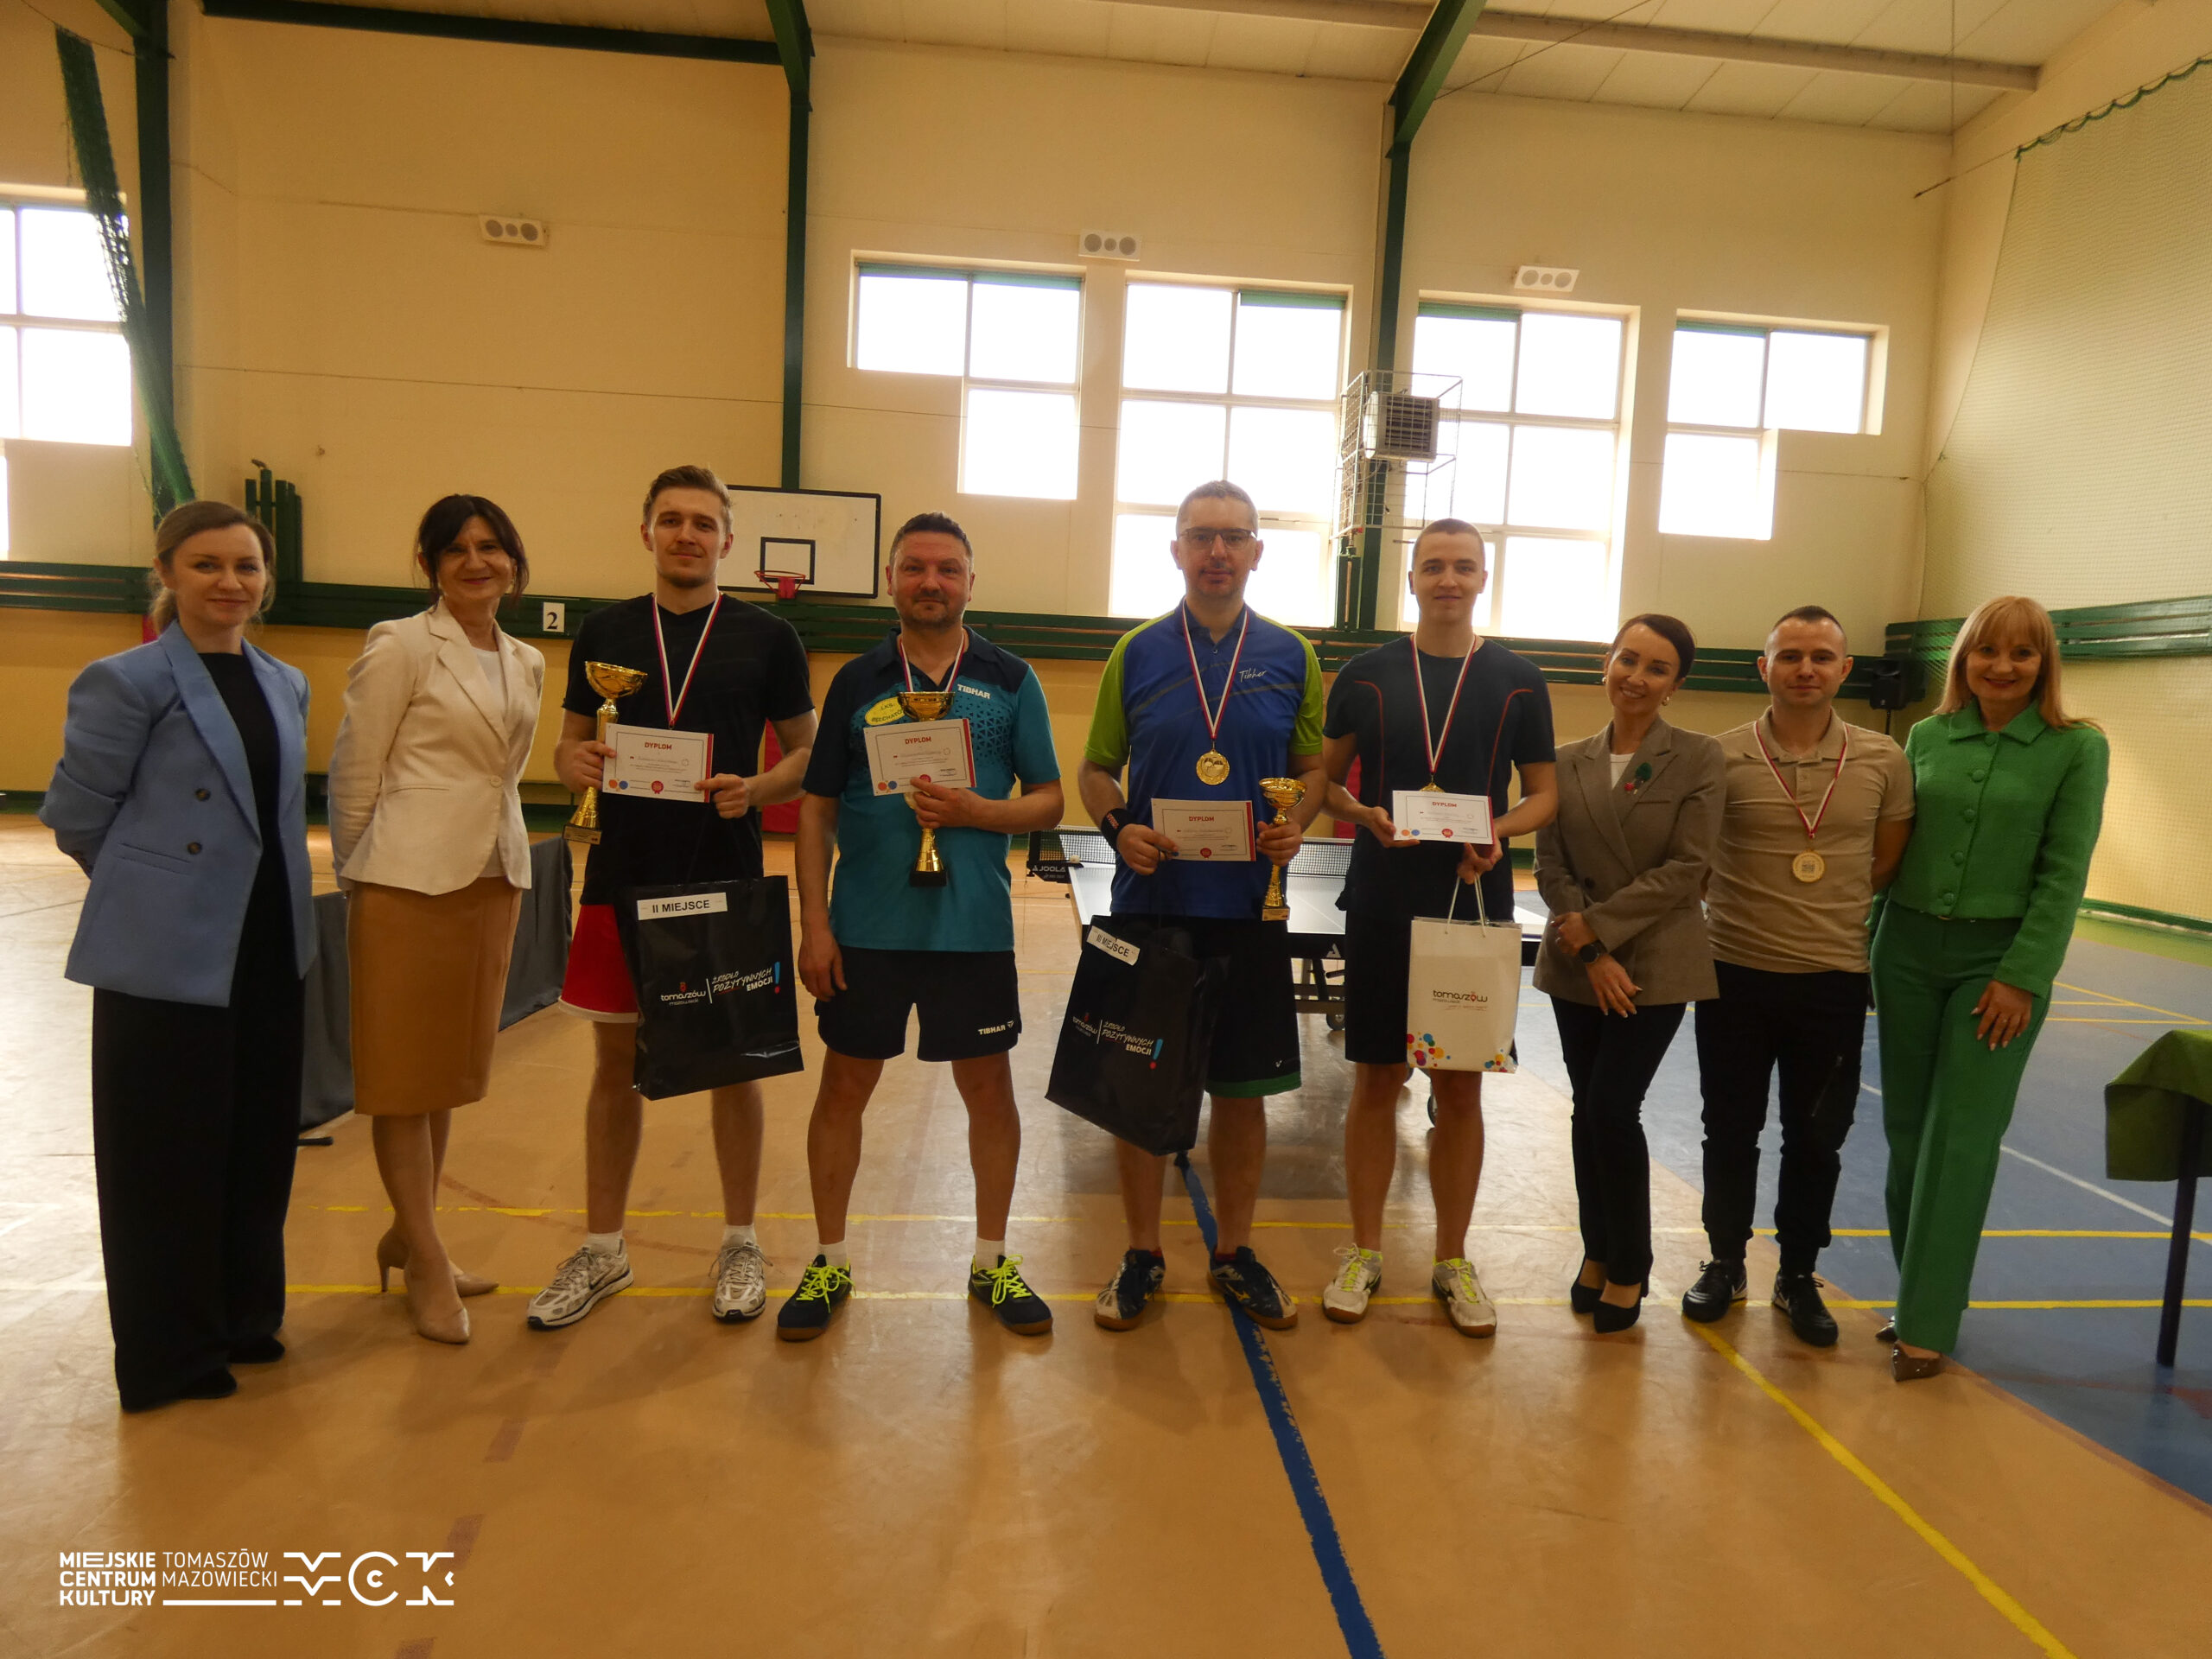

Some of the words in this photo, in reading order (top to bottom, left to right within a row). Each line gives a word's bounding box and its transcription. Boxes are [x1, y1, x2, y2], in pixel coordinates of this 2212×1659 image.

[546, 611, 558, 630] 2
[957, 683, 991, 700] TIBHAR
[644, 741, 673, 751] DYPLOM
[904, 735, 932, 745] DYPLOM
[652, 904, 659, 914] II
[662, 899, 710, 912] MIEJSCE
[1102, 938, 1130, 957] MIEJSCE
[747, 976, 773, 992] EMOCJI
[978, 1025, 1006, 1035] TIBHAR
[1126, 1044, 1153, 1056] EMOCJI
